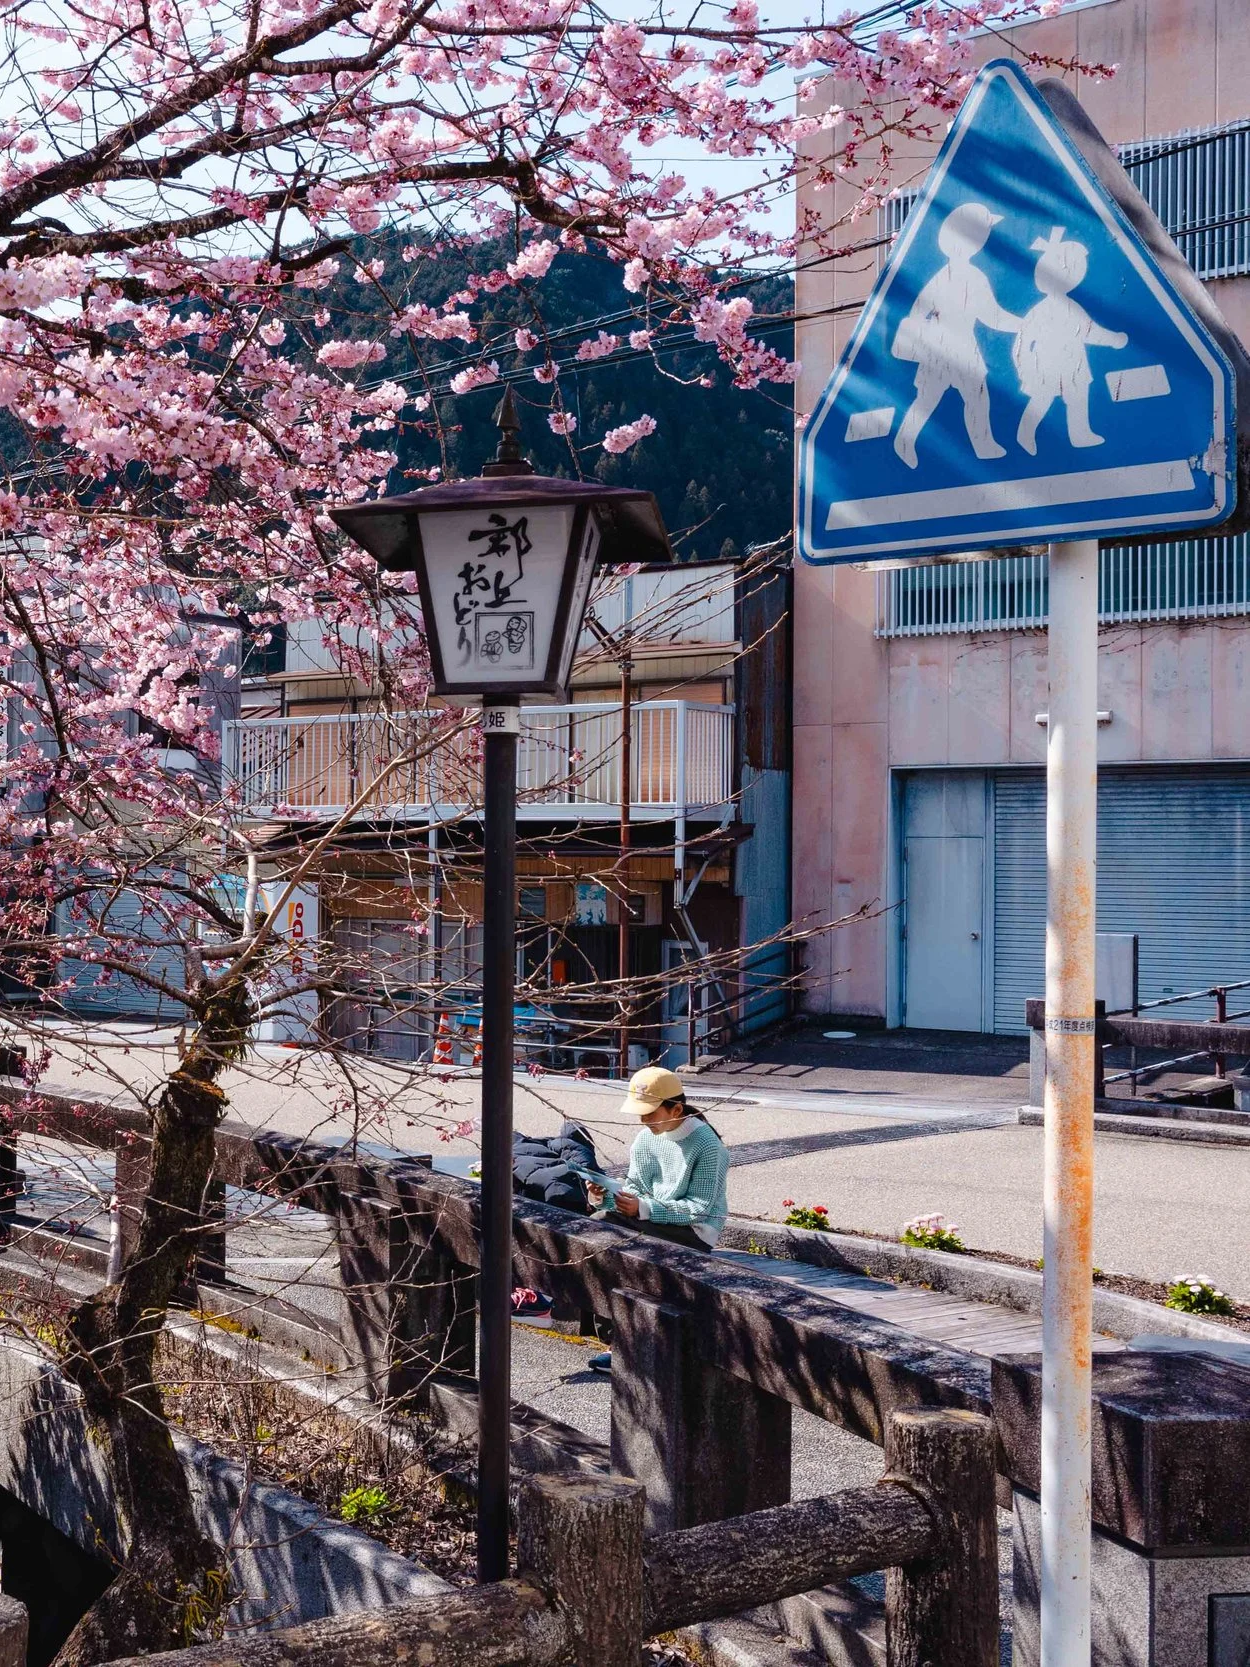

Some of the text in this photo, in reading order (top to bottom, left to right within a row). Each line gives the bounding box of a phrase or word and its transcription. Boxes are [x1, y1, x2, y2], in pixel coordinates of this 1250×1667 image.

[468, 513, 533, 608] 郡上
[453, 561, 491, 669] おどり
[287, 902, 304, 975] DDo
